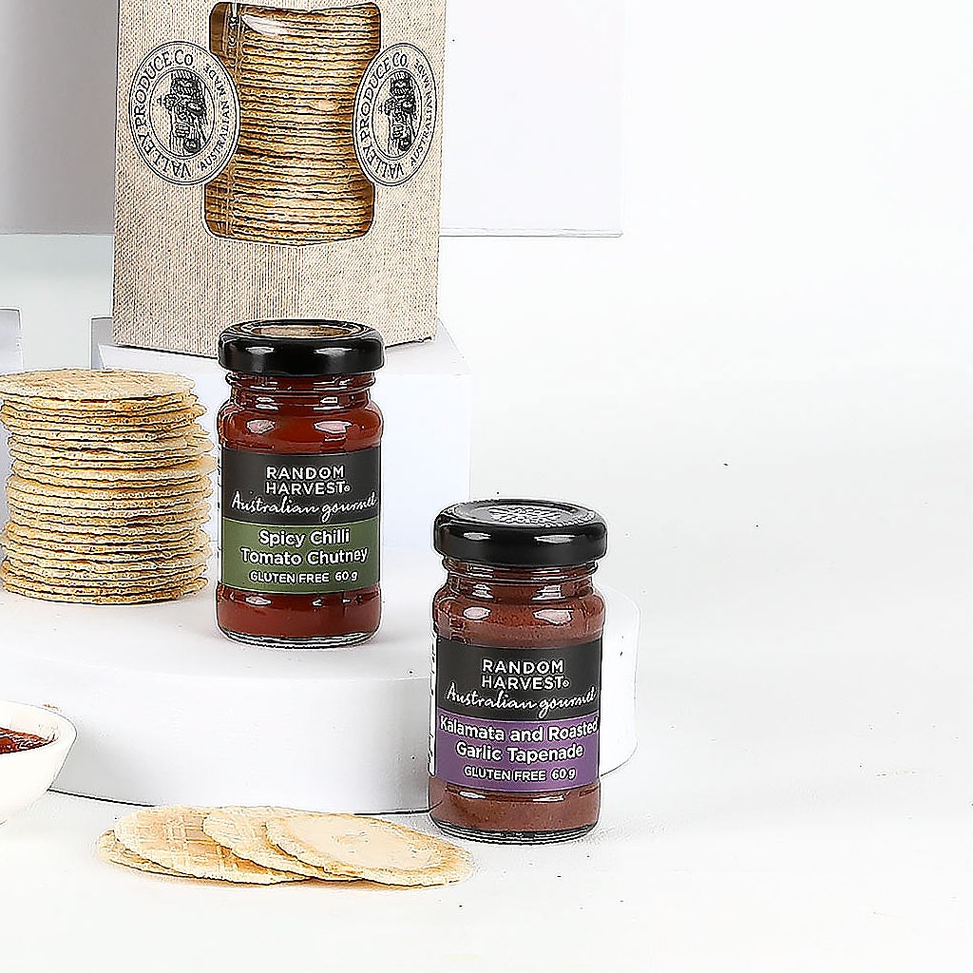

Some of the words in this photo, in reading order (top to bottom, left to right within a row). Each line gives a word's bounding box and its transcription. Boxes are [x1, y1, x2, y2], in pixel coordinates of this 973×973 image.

[134, 51, 173, 129] PRODUCE
[205, 64, 227, 96] MADE
[360, 56, 391, 142] PRODUCE
[198, 100, 230, 171] AUSTRALIAN
[136, 132, 191, 178] VALLEY
[363, 141, 404, 178] VALLEY
[266, 465, 345, 479] RANDOM
[231, 490, 319, 514] Australian
[321, 491, 377, 523] gourmet
[259, 530, 305, 547] Spicy
[310, 529, 350, 545] Chilli
[240, 547, 302, 565] Tomato
[307, 547, 368, 565] Chutney
[249, 571, 295, 583] GLUTEN
[298, 573, 330, 583] FREE
[482, 659, 564, 674] RANDOM
[446, 682, 537, 709] Australian
[538, 686, 597, 719] gourmet
[440, 715, 505, 739] Kalamata
[510, 727, 543, 742] and
[548, 717, 599, 740] Roasted
[456, 741, 502, 761] Garlic
[507, 743, 584, 765] Tapenade
[464, 766, 512, 780] GLUTEN
[515, 770, 546, 781] FREE
